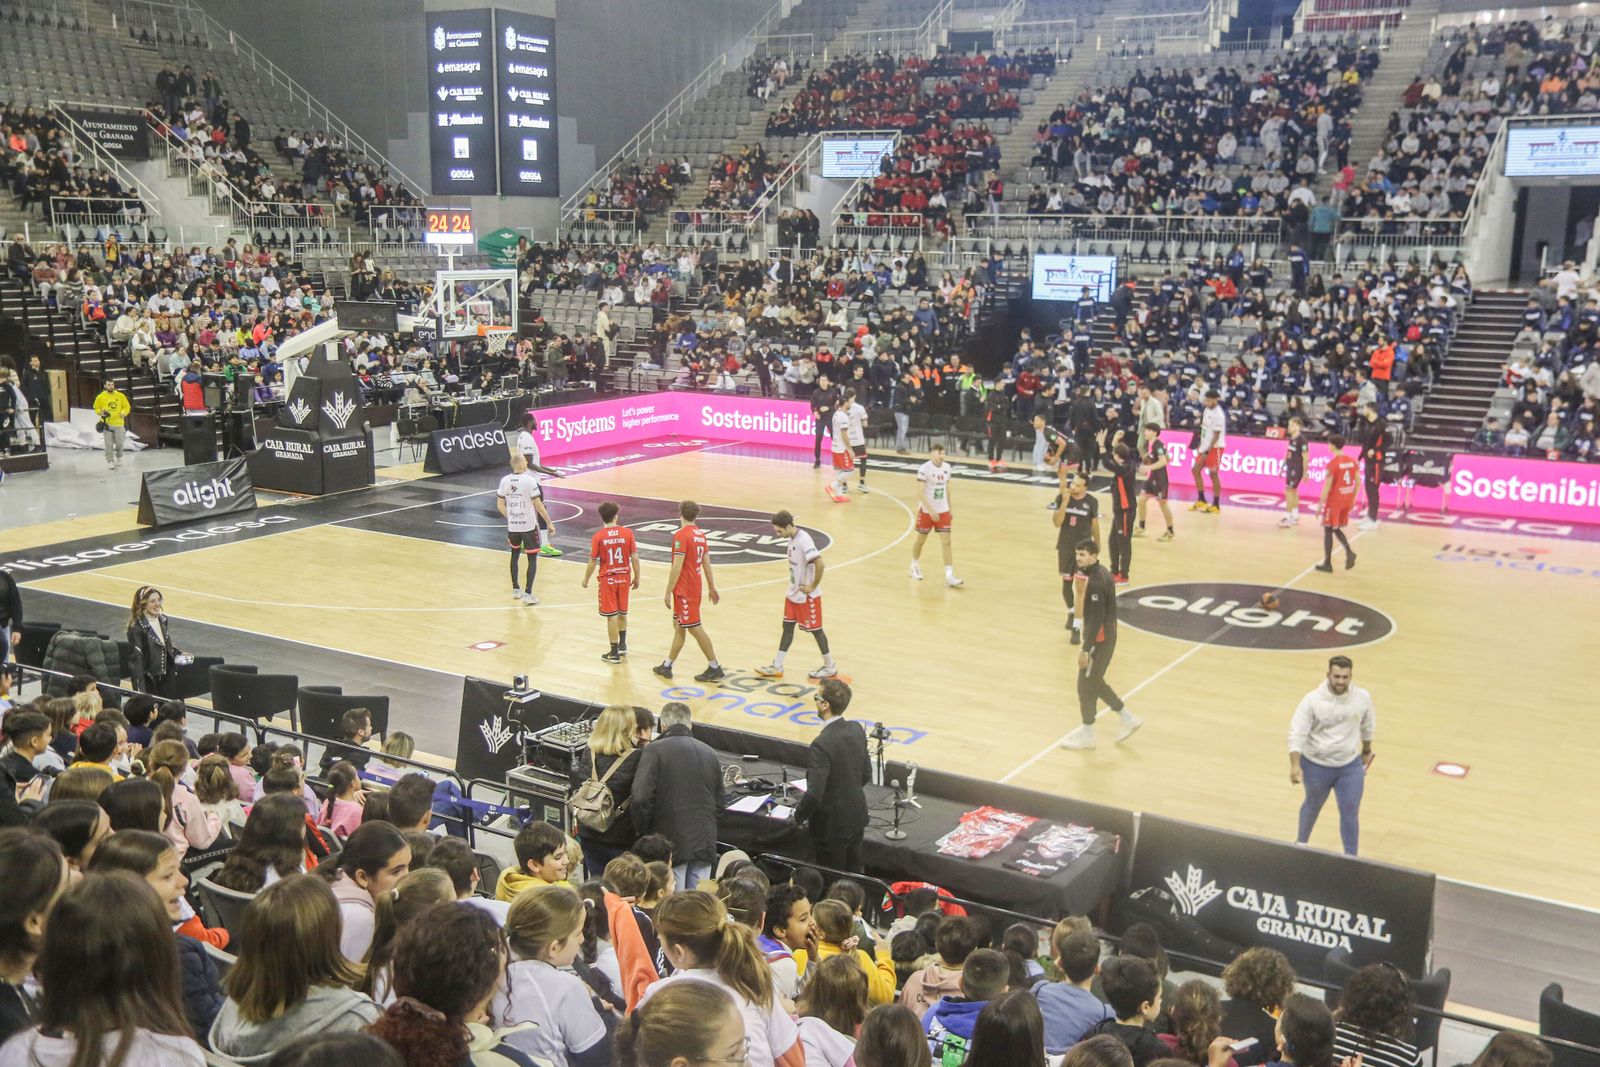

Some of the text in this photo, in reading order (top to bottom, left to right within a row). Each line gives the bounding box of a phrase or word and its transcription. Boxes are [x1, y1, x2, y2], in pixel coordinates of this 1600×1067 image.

[444, 62, 481, 74] emasagra
[515, 65, 548, 78] emasagra
[429, 215, 471, 233] 24 24
[622, 406, 655, 418] Let's power
[622, 412, 680, 430] higher performance
[557, 415, 616, 442] Systems
[265, 439, 314, 454] CAJA RURAL
[323, 440, 366, 453] CAJA RURAL
[440, 429, 505, 453] endesa
[275, 451, 305, 461] GRANADA
[332, 449, 358, 459] GRANADA
[173, 477, 236, 509] alight
[608, 547, 624, 566] 14
[1138, 595, 1365, 636] alight
[660, 685, 928, 745] endea
[1226, 885, 1392, 944] CAJA RURAL
[1256, 916, 1354, 954] GRANADA
